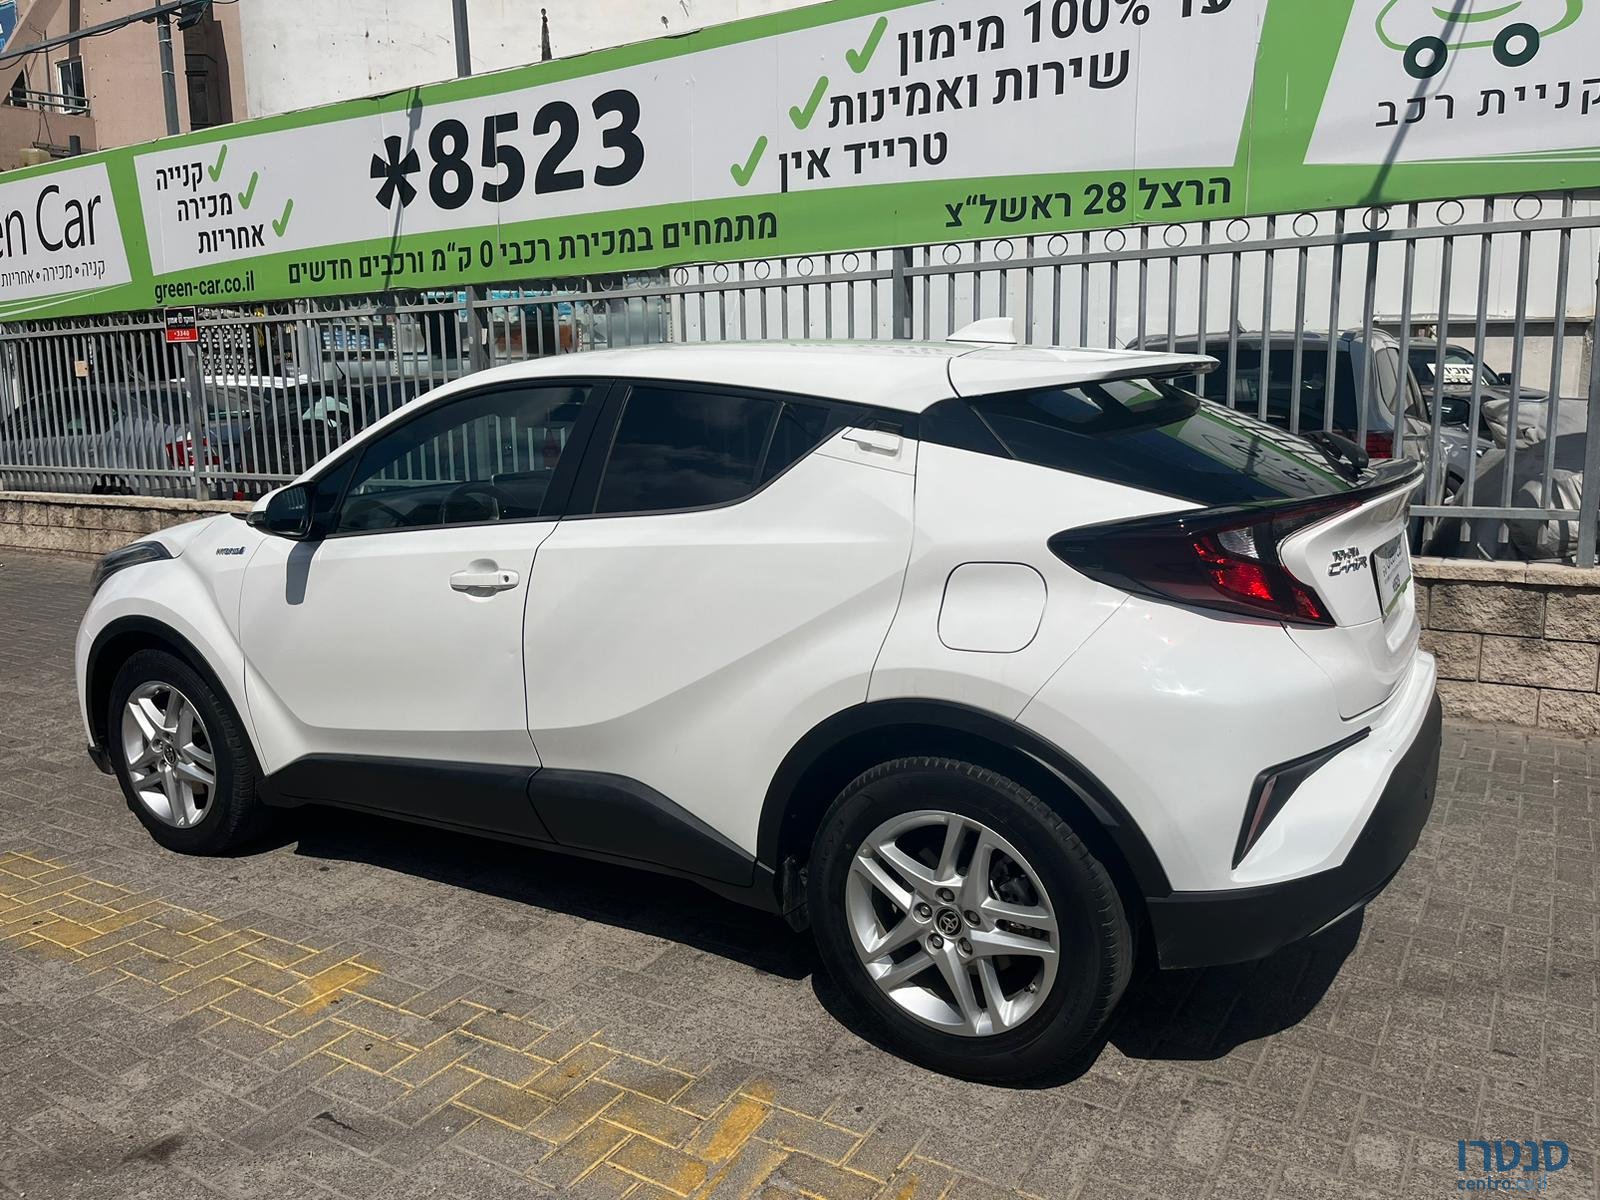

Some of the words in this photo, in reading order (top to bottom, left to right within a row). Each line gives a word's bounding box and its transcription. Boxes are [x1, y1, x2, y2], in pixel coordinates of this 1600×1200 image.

[898, 15, 1004, 77] מימון
[992, 49, 1130, 105] שירות
[828, 73, 978, 128] ואמינות
[1375, 94, 1454, 127] רכב
[1477, 78, 1600, 117] קניית
[843, 131, 948, 175] טרייד
[156, 162, 203, 192] קנייה
[778, 147, 831, 194] אין
[177, 192, 233, 222] מכירה
[1083, 181, 1127, 216] 28
[1138, 177, 1231, 210] הרצל
[0, 210, 27, 259] n
[36, 184, 101, 252] Car
[662, 211, 777, 249] מתמחים
[198, 223, 265, 254] אחריות
[479, 239, 494, 268] 0
[499, 238, 551, 266] רכבי
[558, 226, 654, 261] במכירת
[0, 269, 35, 288] אחריות
[42, 264, 73, 282] מכירה
[81, 260, 106, 280] קניה
[288, 258, 353, 284] חדשים
[359, 250, 424, 278] ורכבים
[154, 270, 254, 303] green-car.co.il
